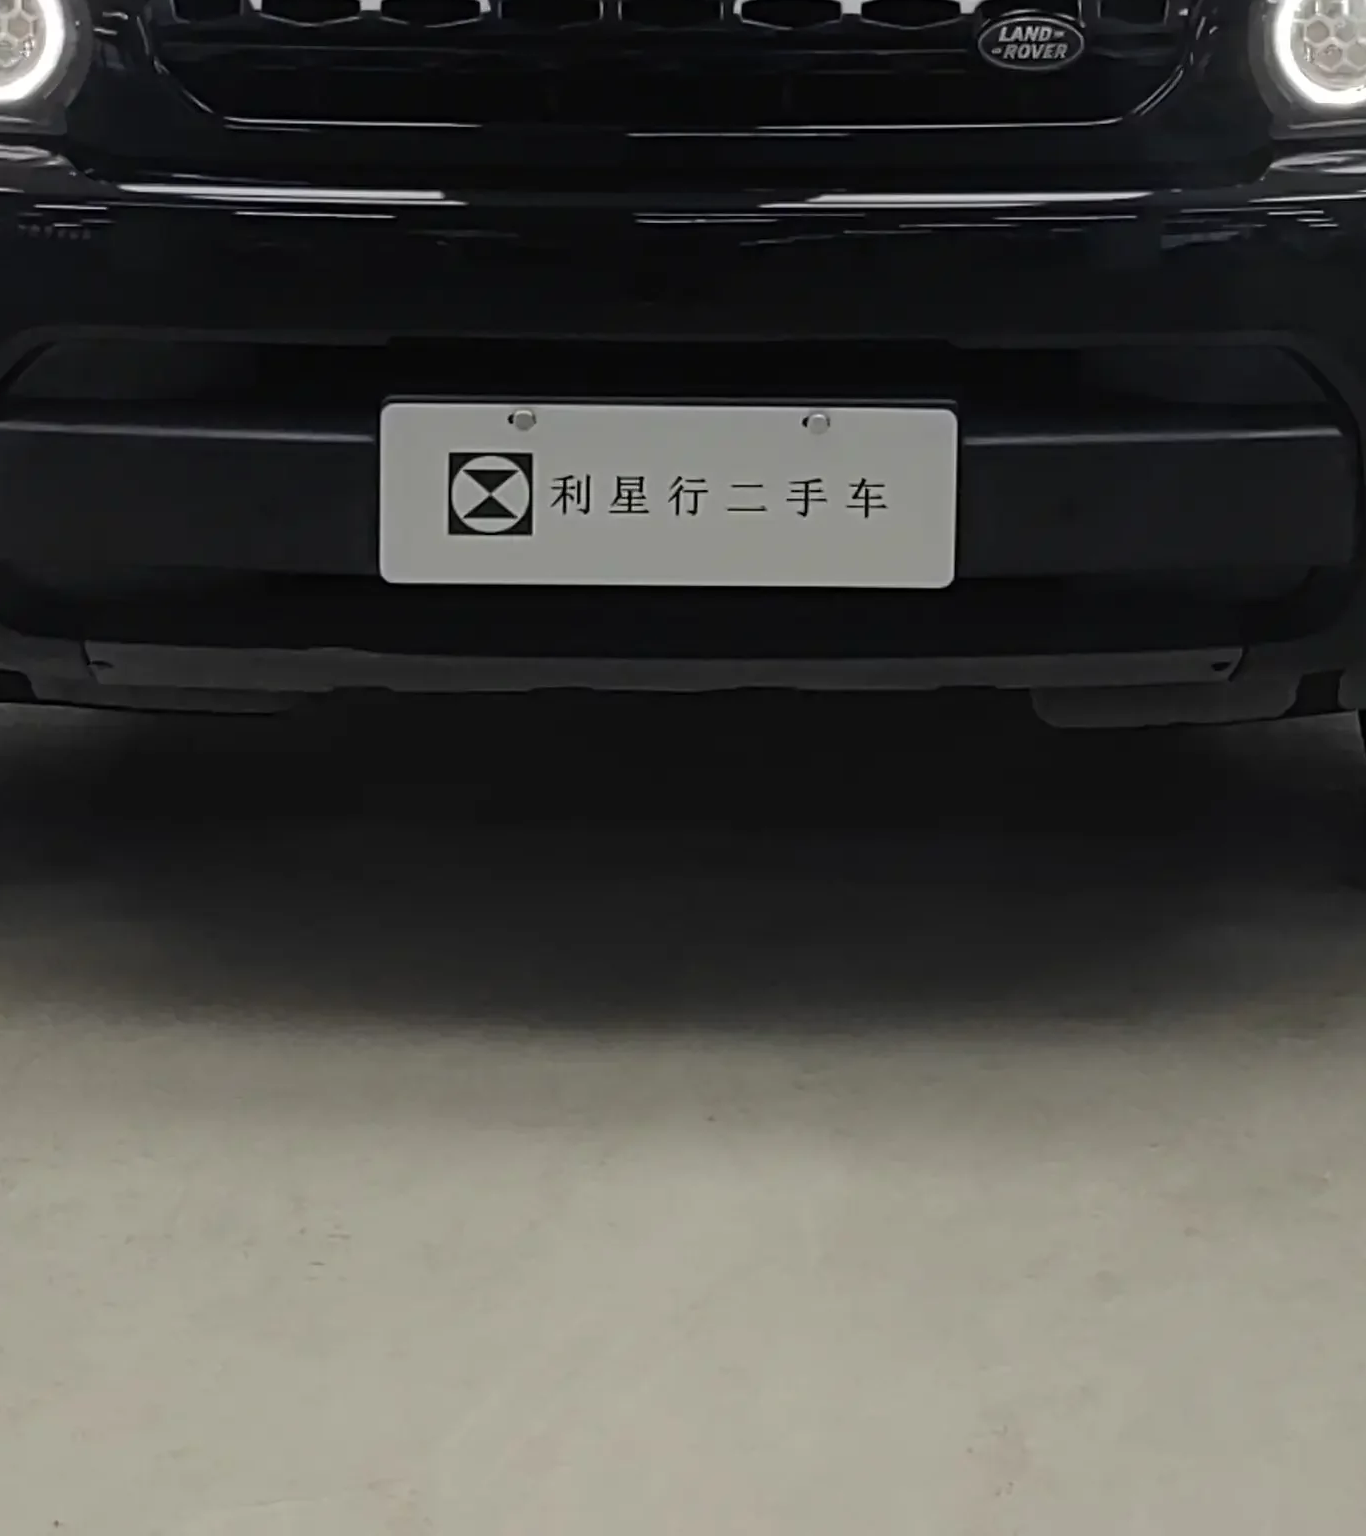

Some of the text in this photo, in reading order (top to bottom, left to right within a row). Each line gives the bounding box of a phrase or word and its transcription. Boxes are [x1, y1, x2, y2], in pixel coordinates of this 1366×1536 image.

[549, 473, 889, 519] 利星行二手车
